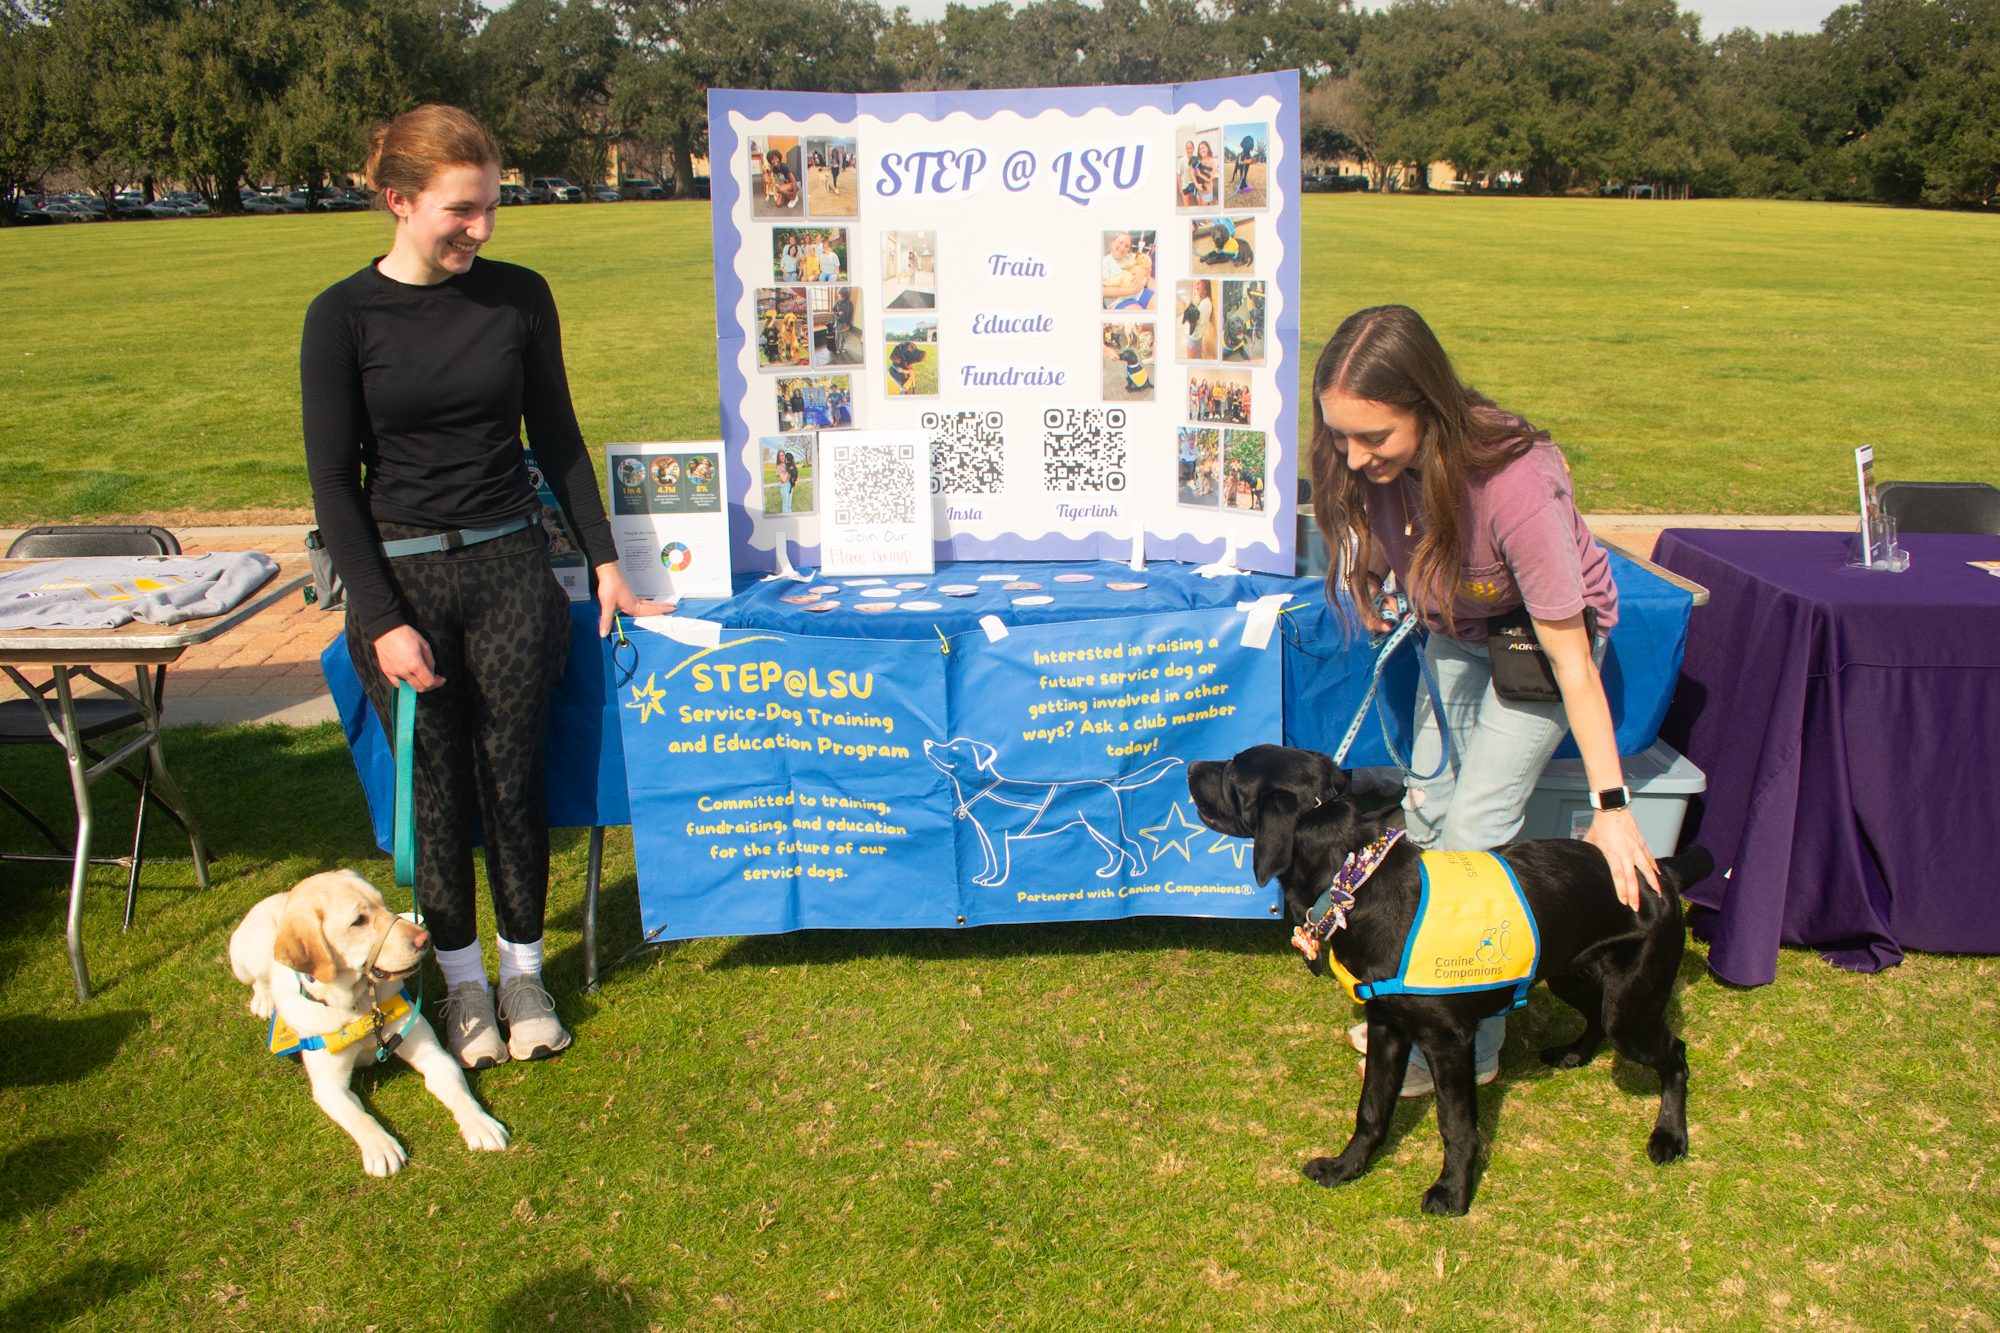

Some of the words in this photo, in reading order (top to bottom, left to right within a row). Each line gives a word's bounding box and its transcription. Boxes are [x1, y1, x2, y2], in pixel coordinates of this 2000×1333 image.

[876, 148, 987, 197] STEP
[1002, 150, 1036, 192] @
[1052, 145, 1144, 207] LSU
[988, 254, 1047, 277] Train
[972, 313, 1054, 334] Educate
[961, 365, 1066, 386] Fundraise
[657, 486, 676, 494] 4.7M
[947, 507, 983, 520] Insta
[1056, 504, 1119, 522] Tigerlink
[844, 529, 878, 542] Join
[884, 531, 907, 542] Our
[830, 548, 866, 565] Flare
[872, 548, 912, 564] Group
[1034, 643, 1123, 665] Interested
[1128, 644, 1142, 656] in
[1147, 638, 1203, 654] raising
[1209, 638, 1219, 648] a
[692, 661, 873, 699] STEP@LSU
[1040, 675, 1094, 689] future
[1100, 668, 1159, 685] service
[1165, 662, 1193, 679] dog
[1198, 663, 1216, 674] or
[1029, 699, 1087, 719] getting
[1093, 689, 1160, 708] involved
[1165, 690, 1179, 702] in
[1184, 683, 1228, 700] other
[679, 703, 802, 726] Service-Dog
[807, 708, 894, 733] Training
[1023, 721, 1074, 743] ways?
[1080, 720, 1113, 734] Ask
[1119, 722, 1128, 731] a
[1134, 714, 1166, 730] club
[1172, 705, 1236, 725] member
[669, 734, 706, 753] and
[713, 733, 812, 753] Education
[818, 737, 909, 761] Program
[1106, 738, 1158, 756] today!
[698, 791, 794, 812] Committed
[800, 793, 816, 806] to
[822, 795, 891, 816] training,
[686, 820, 787, 836] fundraising,
[793, 816, 821, 830] and
[827, 818, 906, 834] education
[710, 845, 737, 859] for
[743, 843, 771, 856] the
[778, 840, 830, 854] future
[835, 842, 853, 854] of
[859, 846, 887, 854] our
[743, 865, 802, 880] service
[808, 864, 848, 881] dogs.
[1017, 889, 1083, 902] Partnered
[1087, 886, 1114, 898] with
[1118, 884, 1160, 898] Canine
[1435, 955, 1474, 967] Canine
